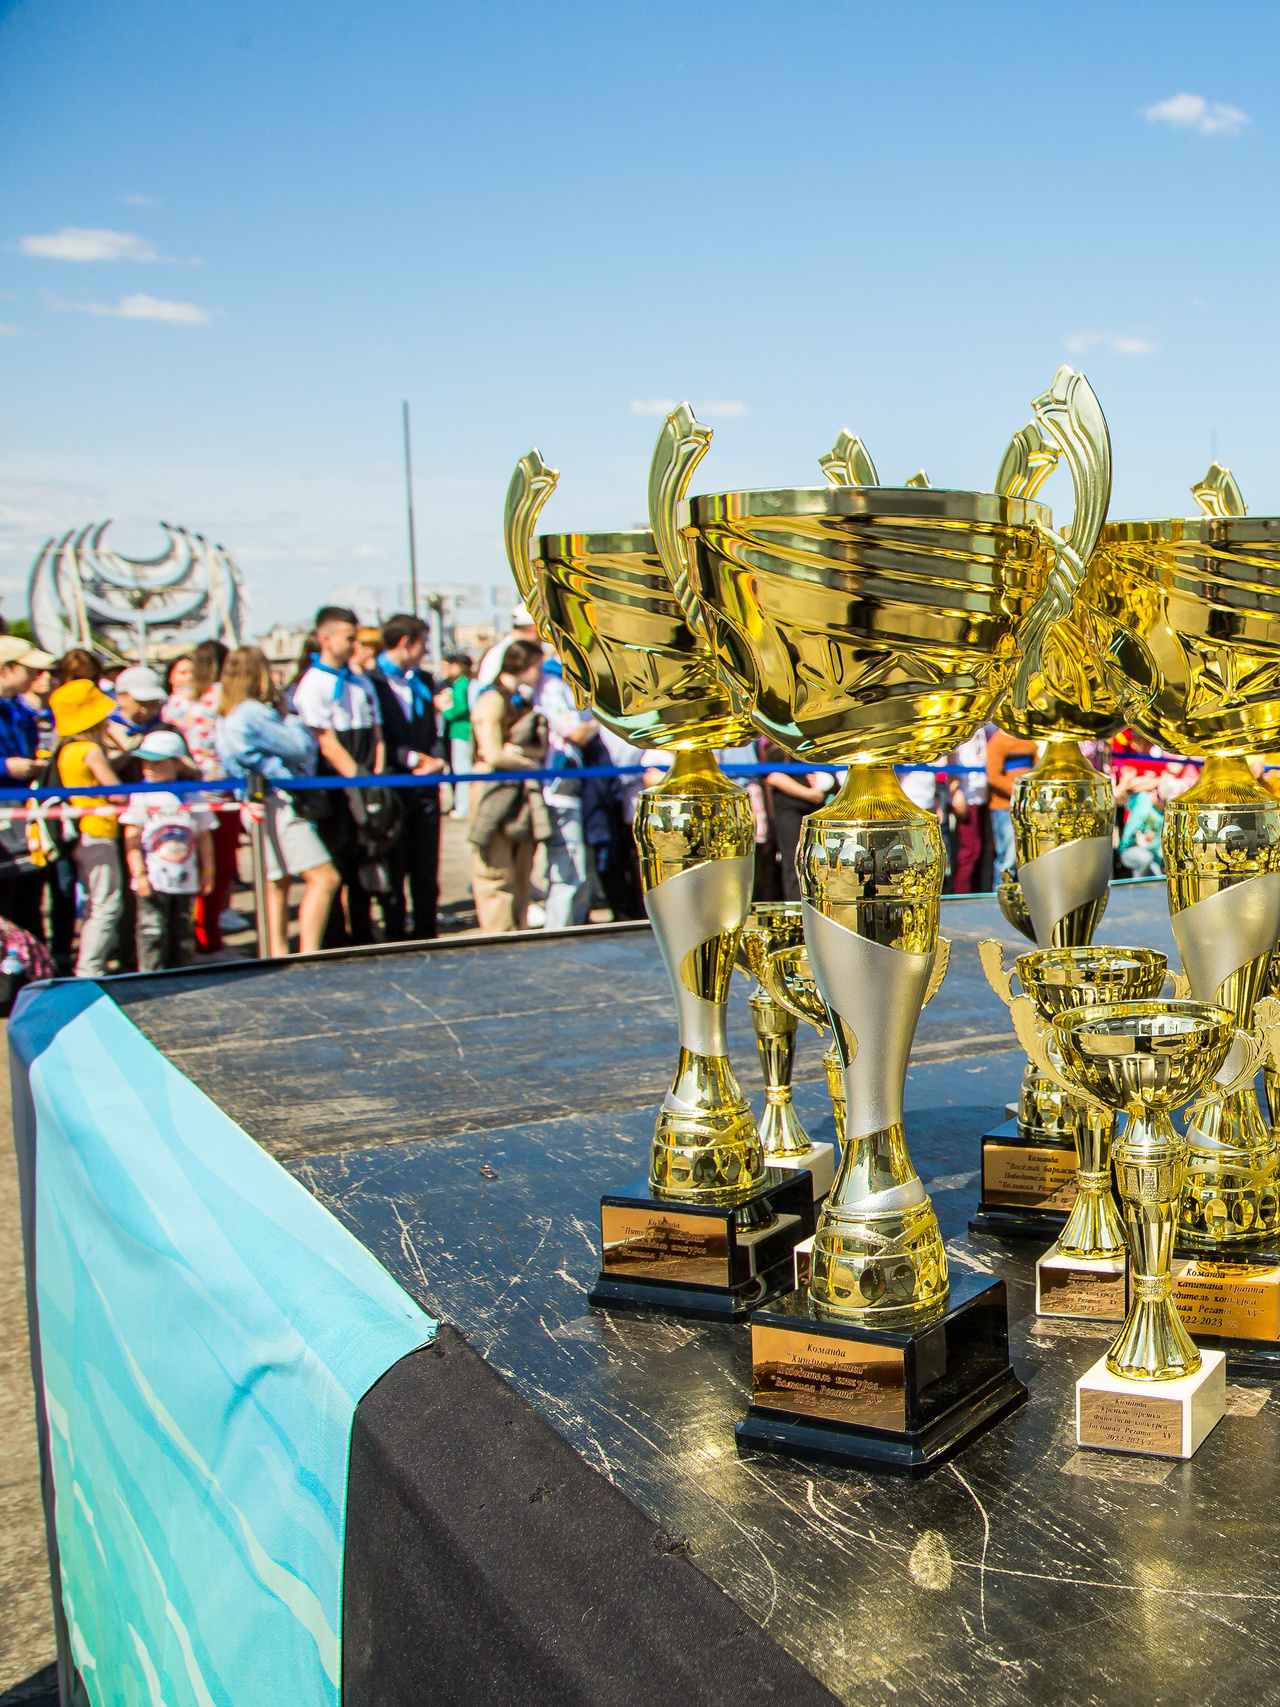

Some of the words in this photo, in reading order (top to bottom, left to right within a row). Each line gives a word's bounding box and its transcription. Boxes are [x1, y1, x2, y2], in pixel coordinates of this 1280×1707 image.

[1028, 1155, 1059, 1163] Команда
[1004, 1172, 1046, 1182] Победитель
[1186, 1268, 1226, 1279] Команда
[1177, 1281, 1224, 1291] капитана
[1172, 1290, 1209, 1301] едитель
[1214, 1296, 1257, 1307] конкурса
[1198, 1305, 1232, 1316] Регата
[806, 1343, 846, 1358] Команда
[776, 1364, 832, 1382] Победитель
